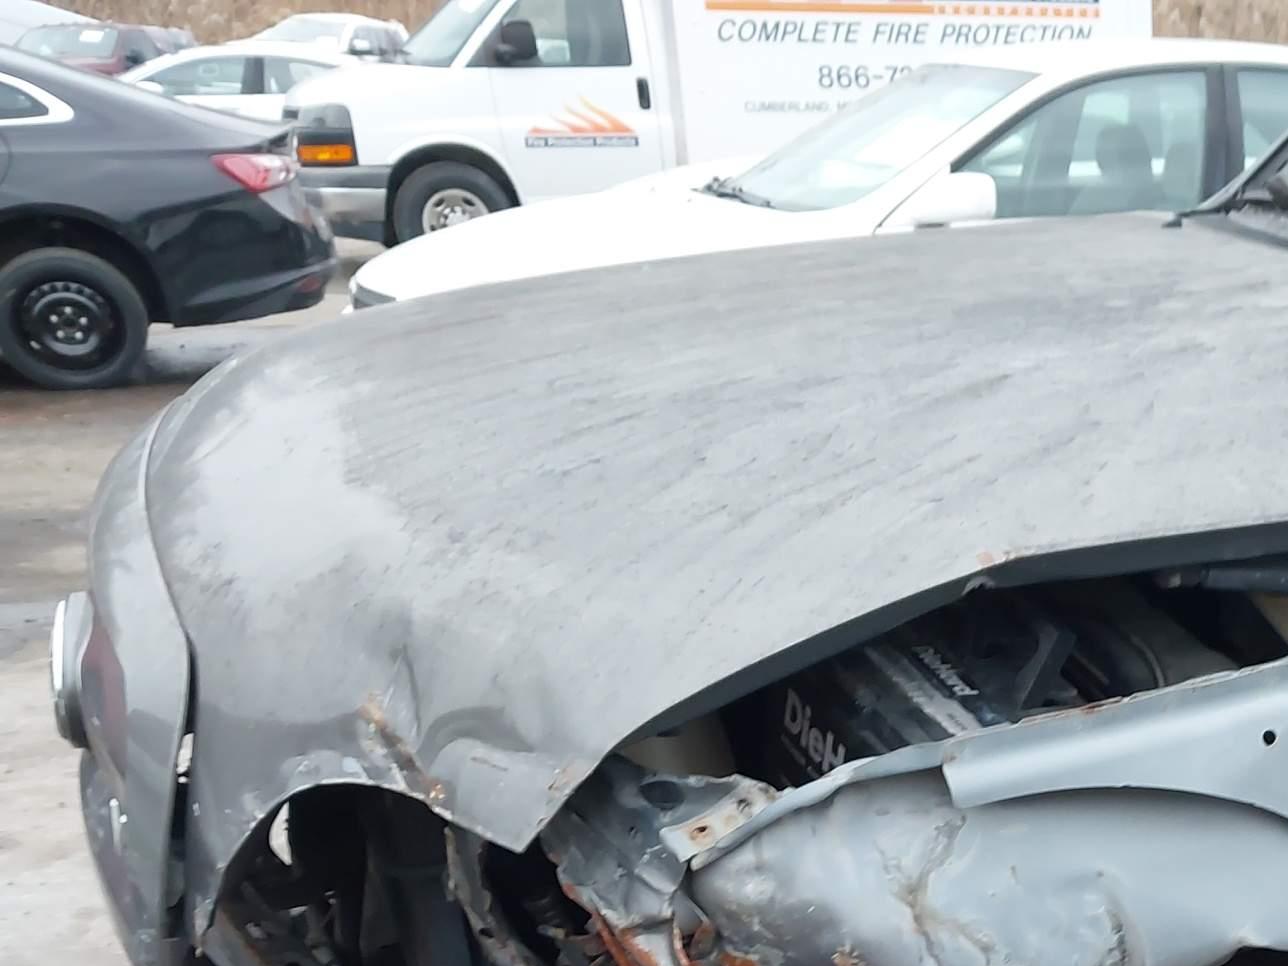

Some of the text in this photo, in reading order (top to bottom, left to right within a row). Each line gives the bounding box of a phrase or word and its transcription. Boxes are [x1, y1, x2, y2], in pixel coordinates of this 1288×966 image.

[717, 19, 1093, 46] COMPLETE FIRE PROTECTION
[783, 689, 847, 772] DieH
